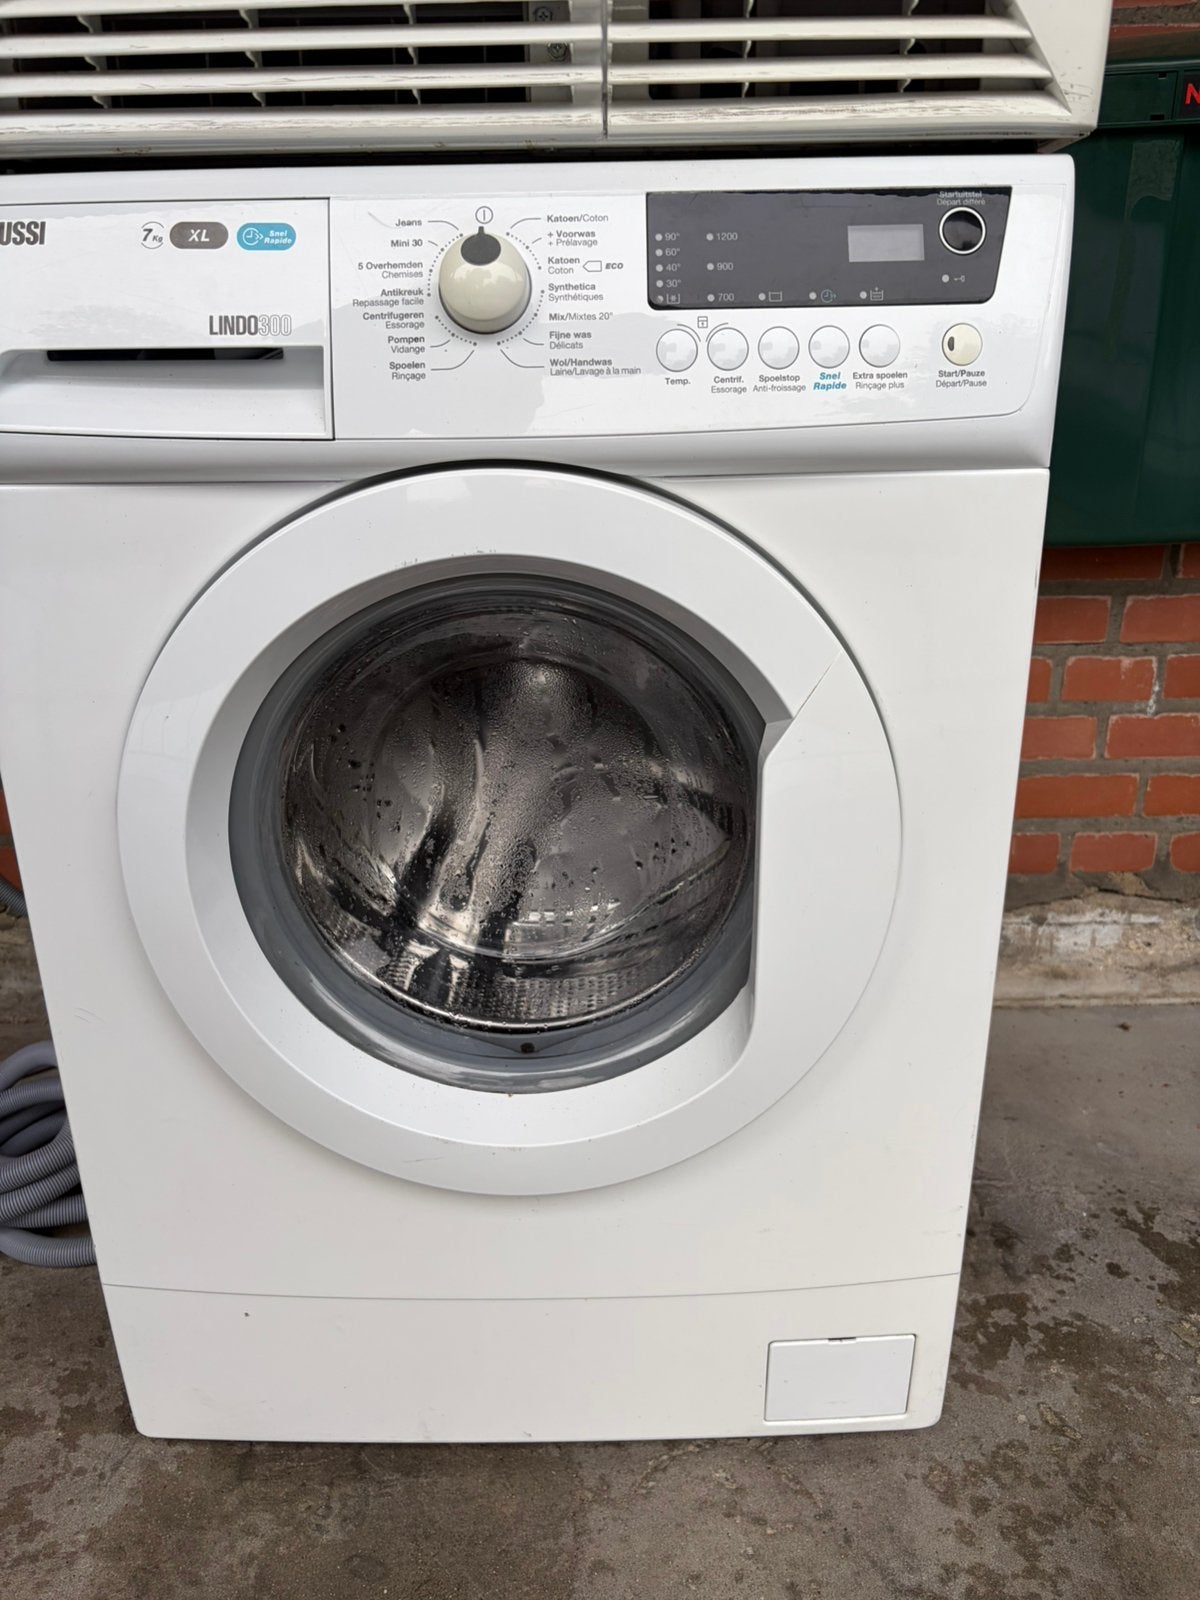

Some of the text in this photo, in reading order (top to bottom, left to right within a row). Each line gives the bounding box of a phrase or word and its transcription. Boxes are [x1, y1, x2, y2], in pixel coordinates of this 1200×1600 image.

[547, 214, 608, 222] Katoen/Coton
[395, 219, 422, 227] Jeans
[0, 221, 46, 245] USSI
[188, 229, 210, 242] XL
[556, 230, 596, 238] Voorwas
[716, 232, 738, 241] 1200
[264, 237, 292, 245] Rapide
[390, 239, 423, 248] Mini 30
[556, 239, 598, 248] Prélavage
[547, 256, 580, 265] Katoen
[358, 261, 423, 270] 5 Overhemden
[605, 262, 624, 270] ECO
[716, 262, 734, 271] 900
[381, 270, 423, 279] Chemises
[547, 266, 574, 275] Coton
[548, 282, 596, 292] Synthetica
[380, 288, 424, 297] Antikreuk
[718, 293, 735, 301] 700
[548, 292, 604, 303] Synthétiques
[352, 297, 424, 308] Repassage facile
[362, 311, 424, 321] Centrifugeren
[549, 312, 597, 321] Mix/Mixtes
[385, 321, 425, 330] Essorage
[387, 336, 425, 344] Pompen
[549, 331, 571, 340] Fijne
[391, 345, 425, 355] Vidange
[549, 341, 583, 350] Délicats
[389, 361, 426, 371] Spoelen
[549, 358, 613, 367] Wol/Handwas
[550, 366, 642, 377] Laine/Lavage à la main
[819, 371, 841, 380] Snel
[852, 371, 908, 381] Extra spoelen
[938, 369, 986, 378] Start/Pauze
[391, 372, 426, 382] Rinçage
[665, 377, 691, 386] Temp.
[713, 375, 744, 384] Centrif.
[758, 374, 800, 383] Spoelstop
[752, 383, 806, 393] Anti-froissage
[813, 381, 847, 391] Rapide
[855, 381, 905, 391] Rinçage plus
[936, 379, 988, 388] Départ/Pause
[711, 385, 747, 394] Essorage
